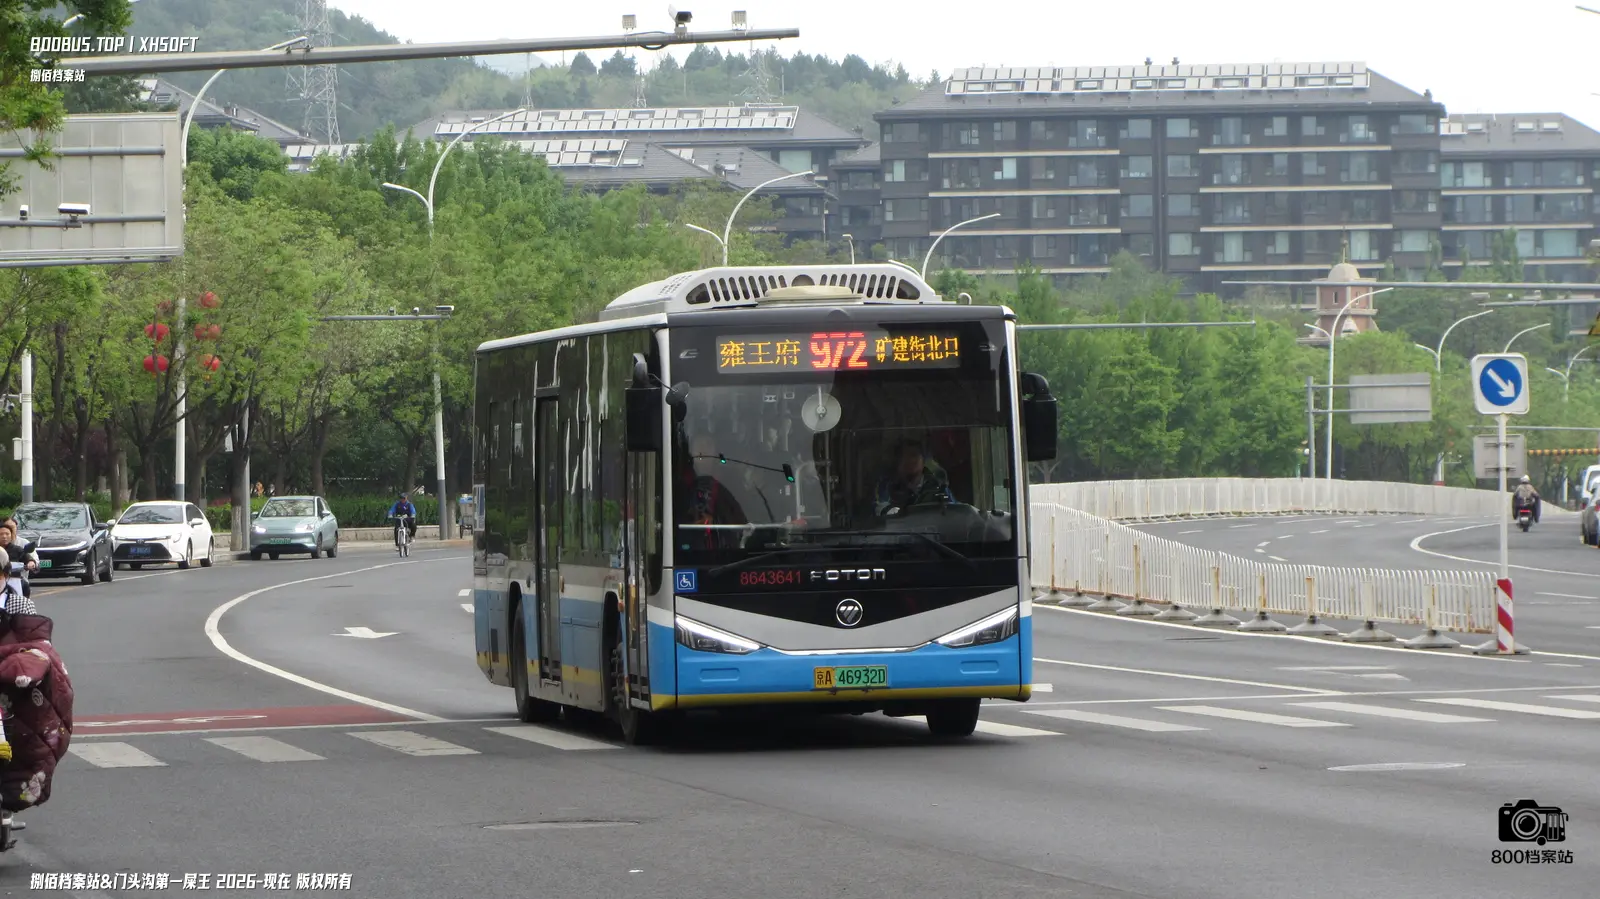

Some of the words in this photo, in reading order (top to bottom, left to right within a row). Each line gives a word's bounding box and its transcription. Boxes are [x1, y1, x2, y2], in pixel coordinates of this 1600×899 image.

[719, 338, 801, 368] 雍王府
[810, 331, 868, 368] 972
[875, 335, 959, 363] 矿建街北口
[740, 571, 801, 586] 8643641
[810, 568, 886, 582] FOTON
